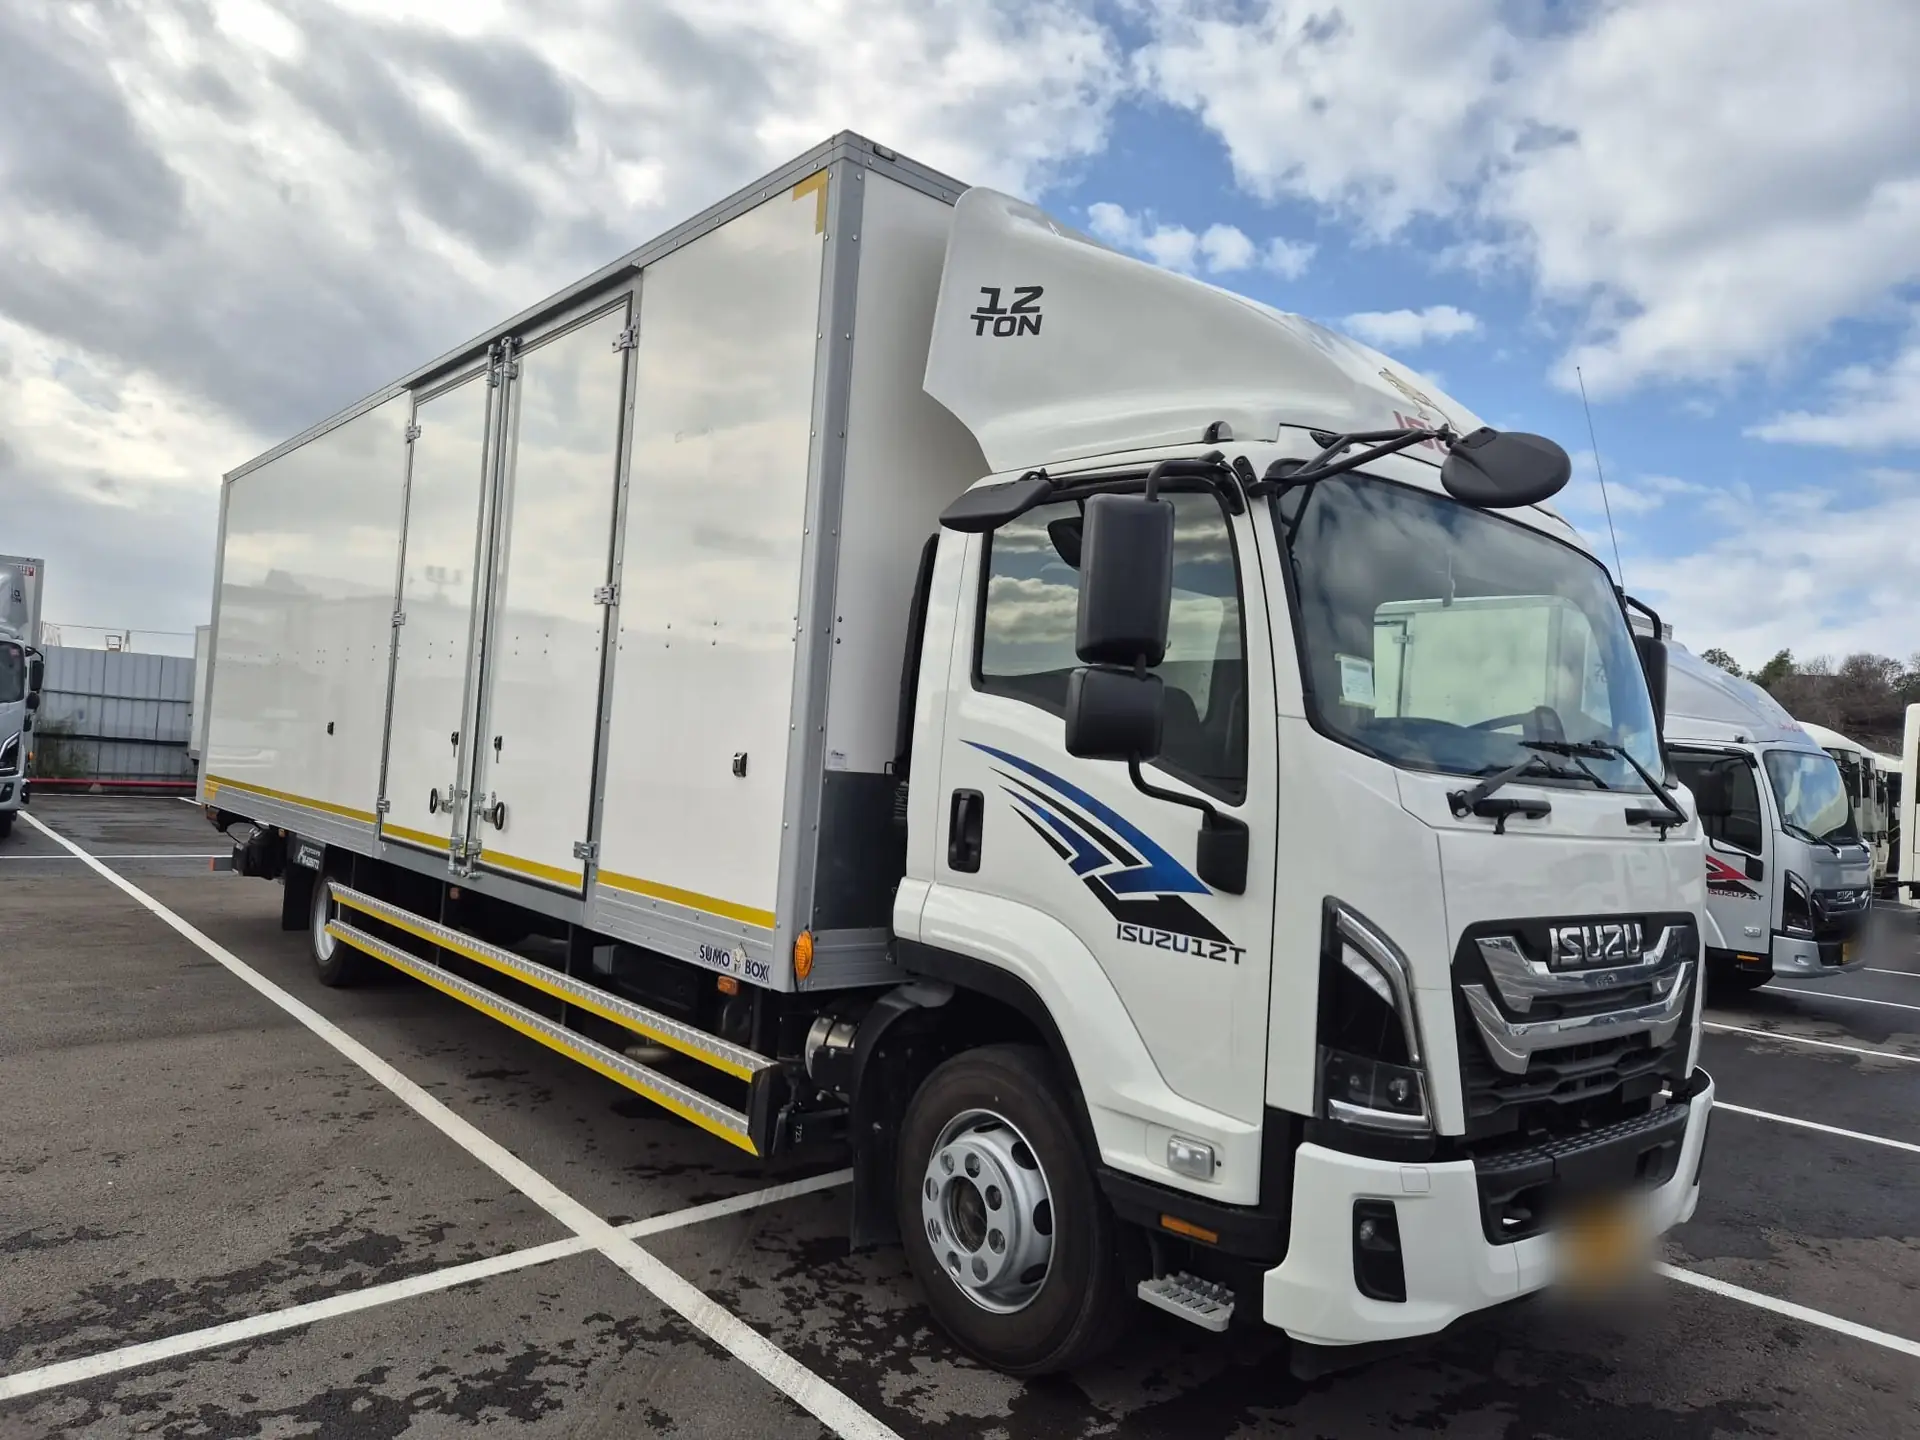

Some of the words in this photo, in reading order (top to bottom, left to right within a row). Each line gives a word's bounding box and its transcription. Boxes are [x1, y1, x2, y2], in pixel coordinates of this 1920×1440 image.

[976, 286, 1044, 315] 12
[970, 314, 1043, 337] TON
[699, 944, 730, 967] SUMO
[1549, 923, 1643, 966] ISUZU
